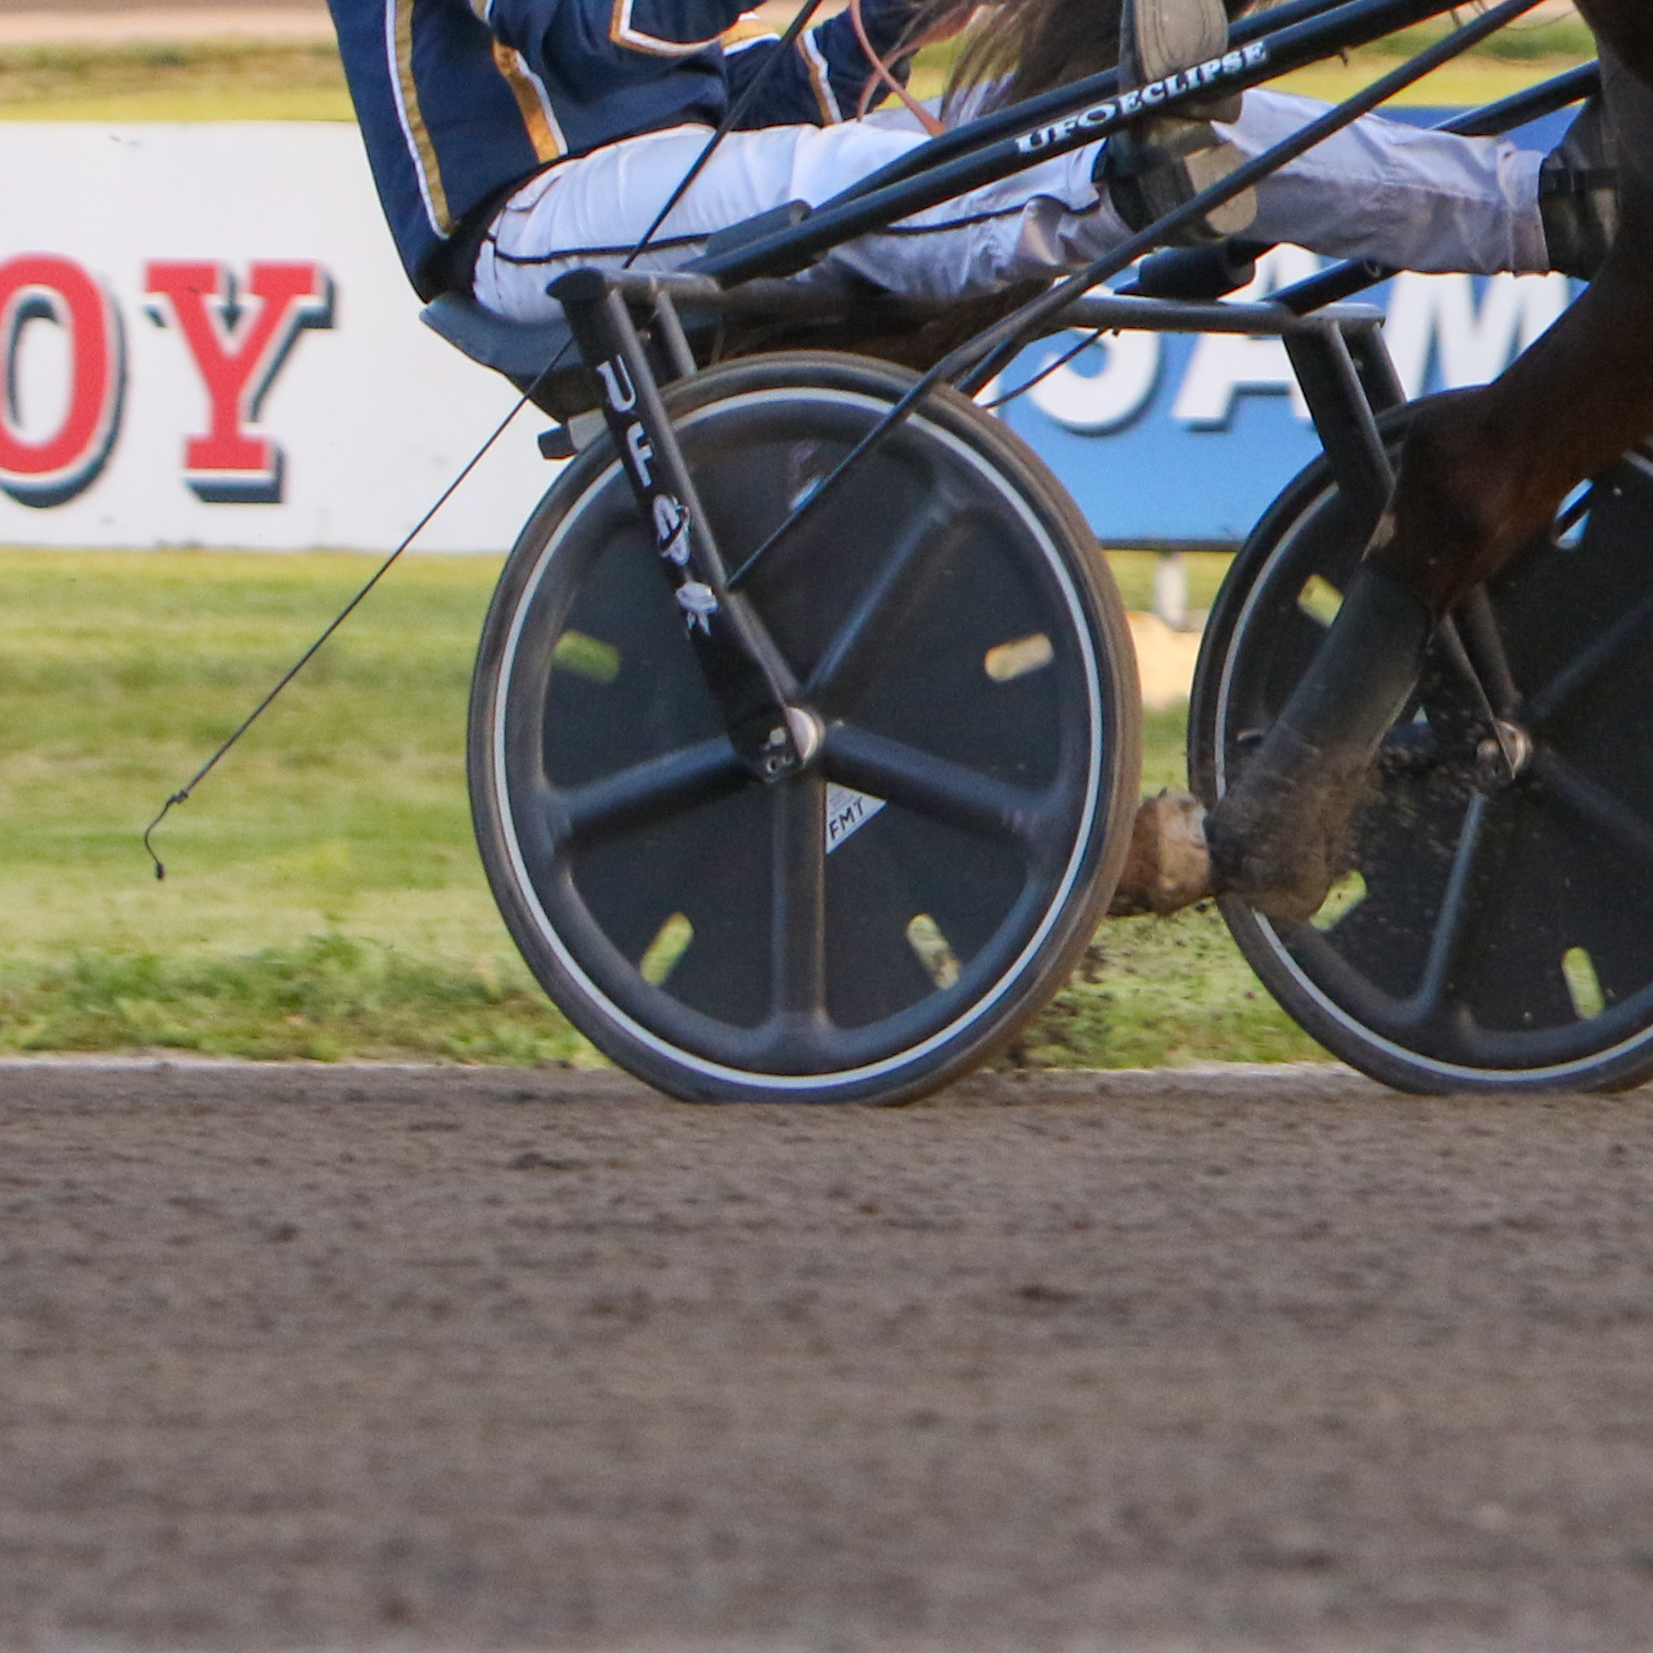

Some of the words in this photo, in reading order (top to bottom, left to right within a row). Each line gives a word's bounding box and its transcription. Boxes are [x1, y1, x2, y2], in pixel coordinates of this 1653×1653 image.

[1015, 104, 1118, 153] UFO
[1119, 40, 1268, 116] ECLIPSE
[0, 252, 328, 483] OY
